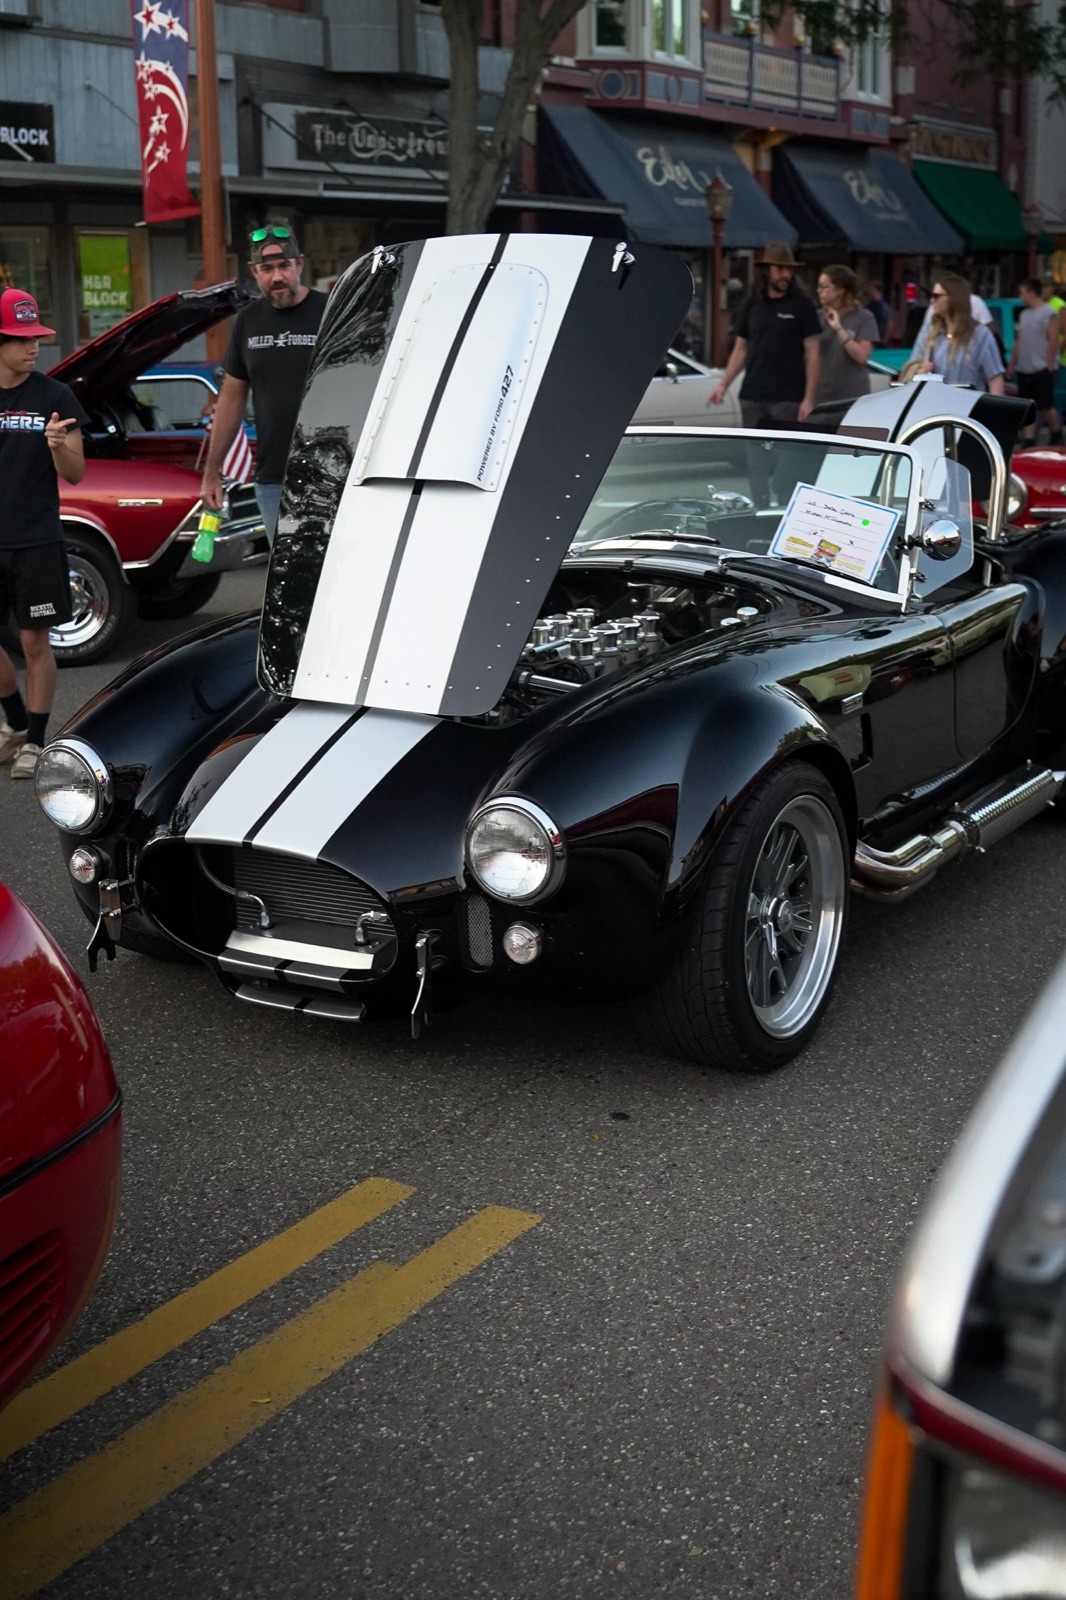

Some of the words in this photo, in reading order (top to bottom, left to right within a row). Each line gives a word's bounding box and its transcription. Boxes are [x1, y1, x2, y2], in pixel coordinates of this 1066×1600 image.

[0, 126, 49, 146] BLOCK
[310, 123, 346, 153] The
[83, 274, 112, 290] H&R
[84, 290, 128, 306] BLOCK
[247, 335, 275, 349] MILLER
[476, 437, 494, 482] POWERED
[490, 422, 497, 437] BY
[494, 398, 505, 423] FORD
[500, 364, 514, 398] 427
